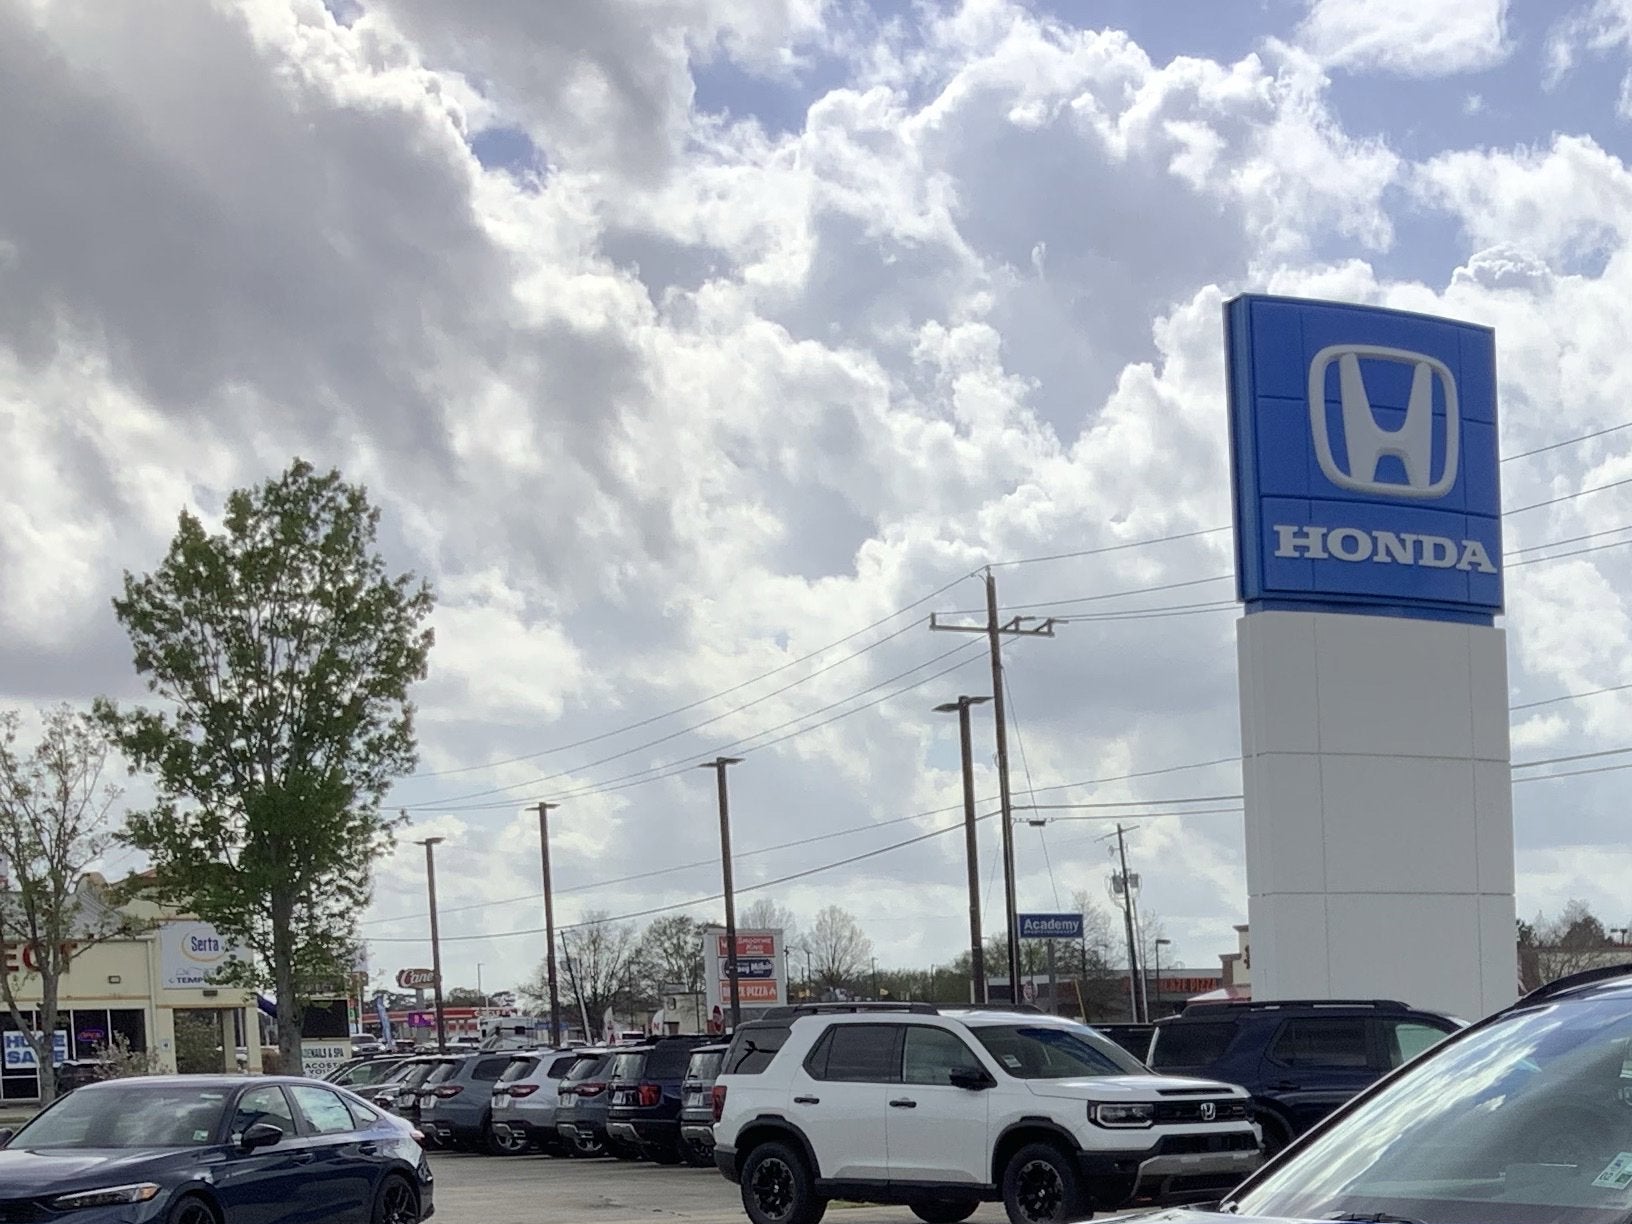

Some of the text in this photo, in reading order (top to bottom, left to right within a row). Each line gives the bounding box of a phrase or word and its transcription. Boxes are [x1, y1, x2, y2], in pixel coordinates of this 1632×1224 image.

[1273, 524, 1497, 574] HONDA
[1024, 918, 1079, 933] Academy
[191, 936, 219, 952] Serta
[747, 986, 769, 998] PIZZA
[5, 1035, 66, 1048] HUE
[7, 1051, 65, 1064] SAE
